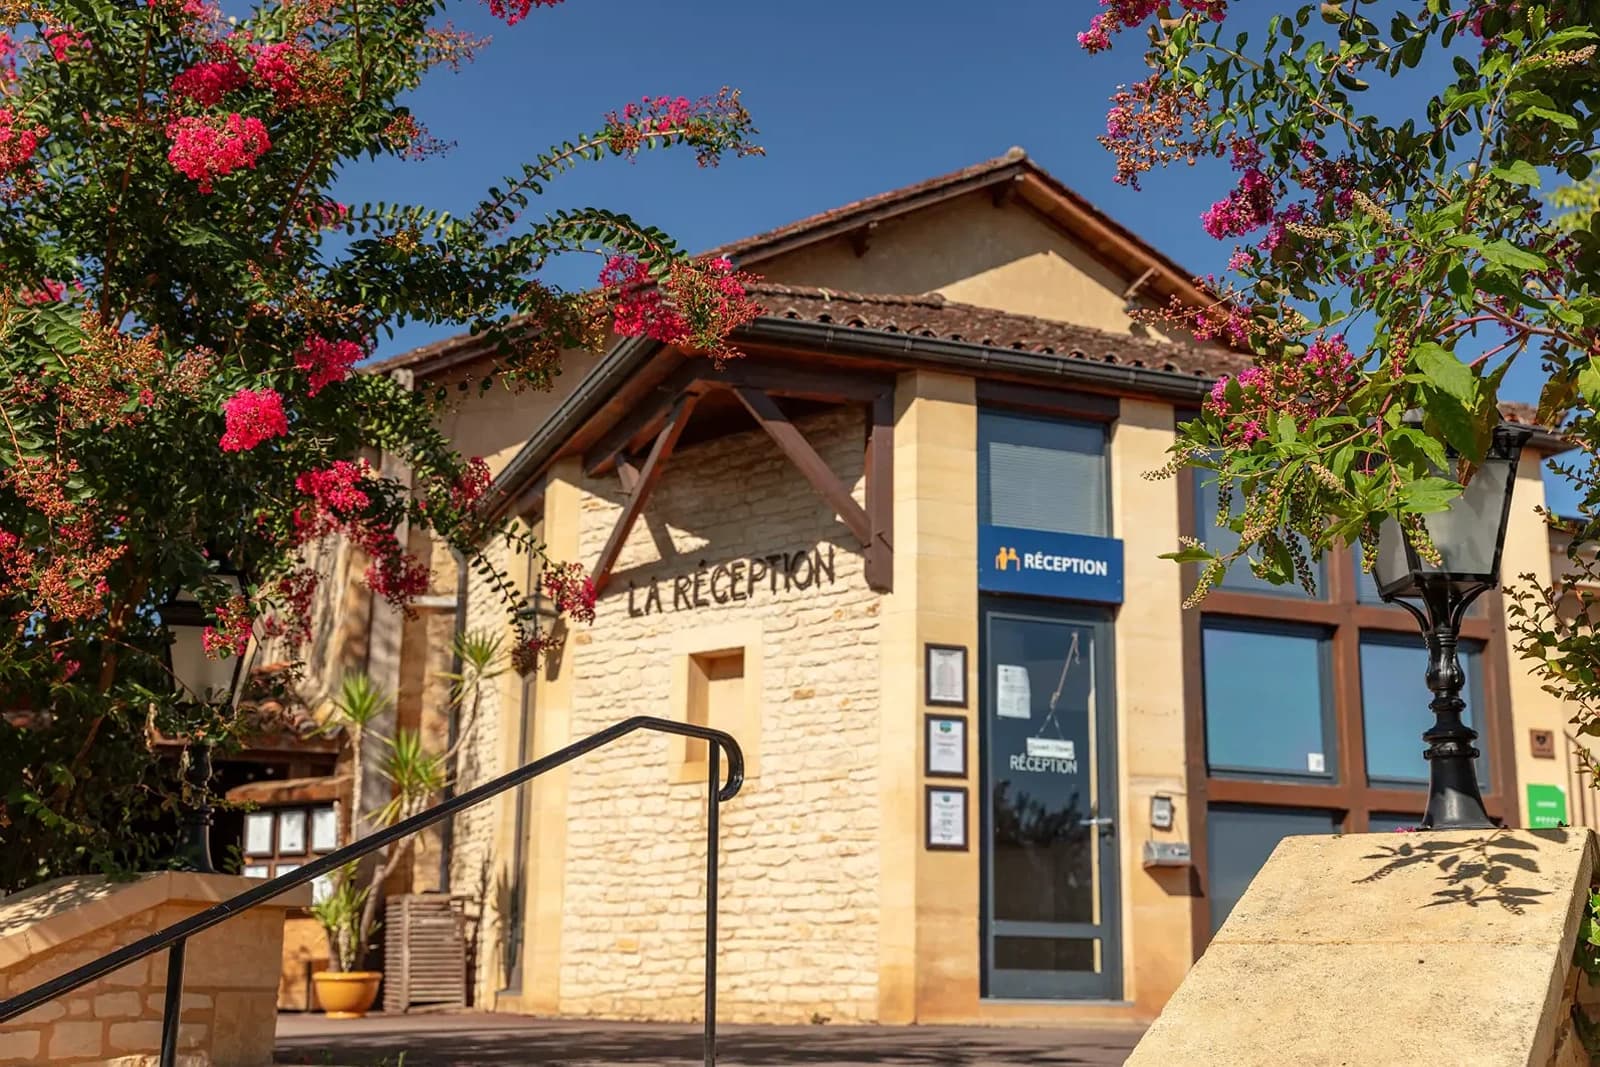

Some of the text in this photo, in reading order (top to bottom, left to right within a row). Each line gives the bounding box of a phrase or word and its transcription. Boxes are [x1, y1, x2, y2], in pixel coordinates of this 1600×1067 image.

[1024, 551, 1108, 576] RÉCEPTION
[627, 543, 835, 618] LA RÉCEPTION
[1010, 753, 1077, 773] RÉCEPTION
